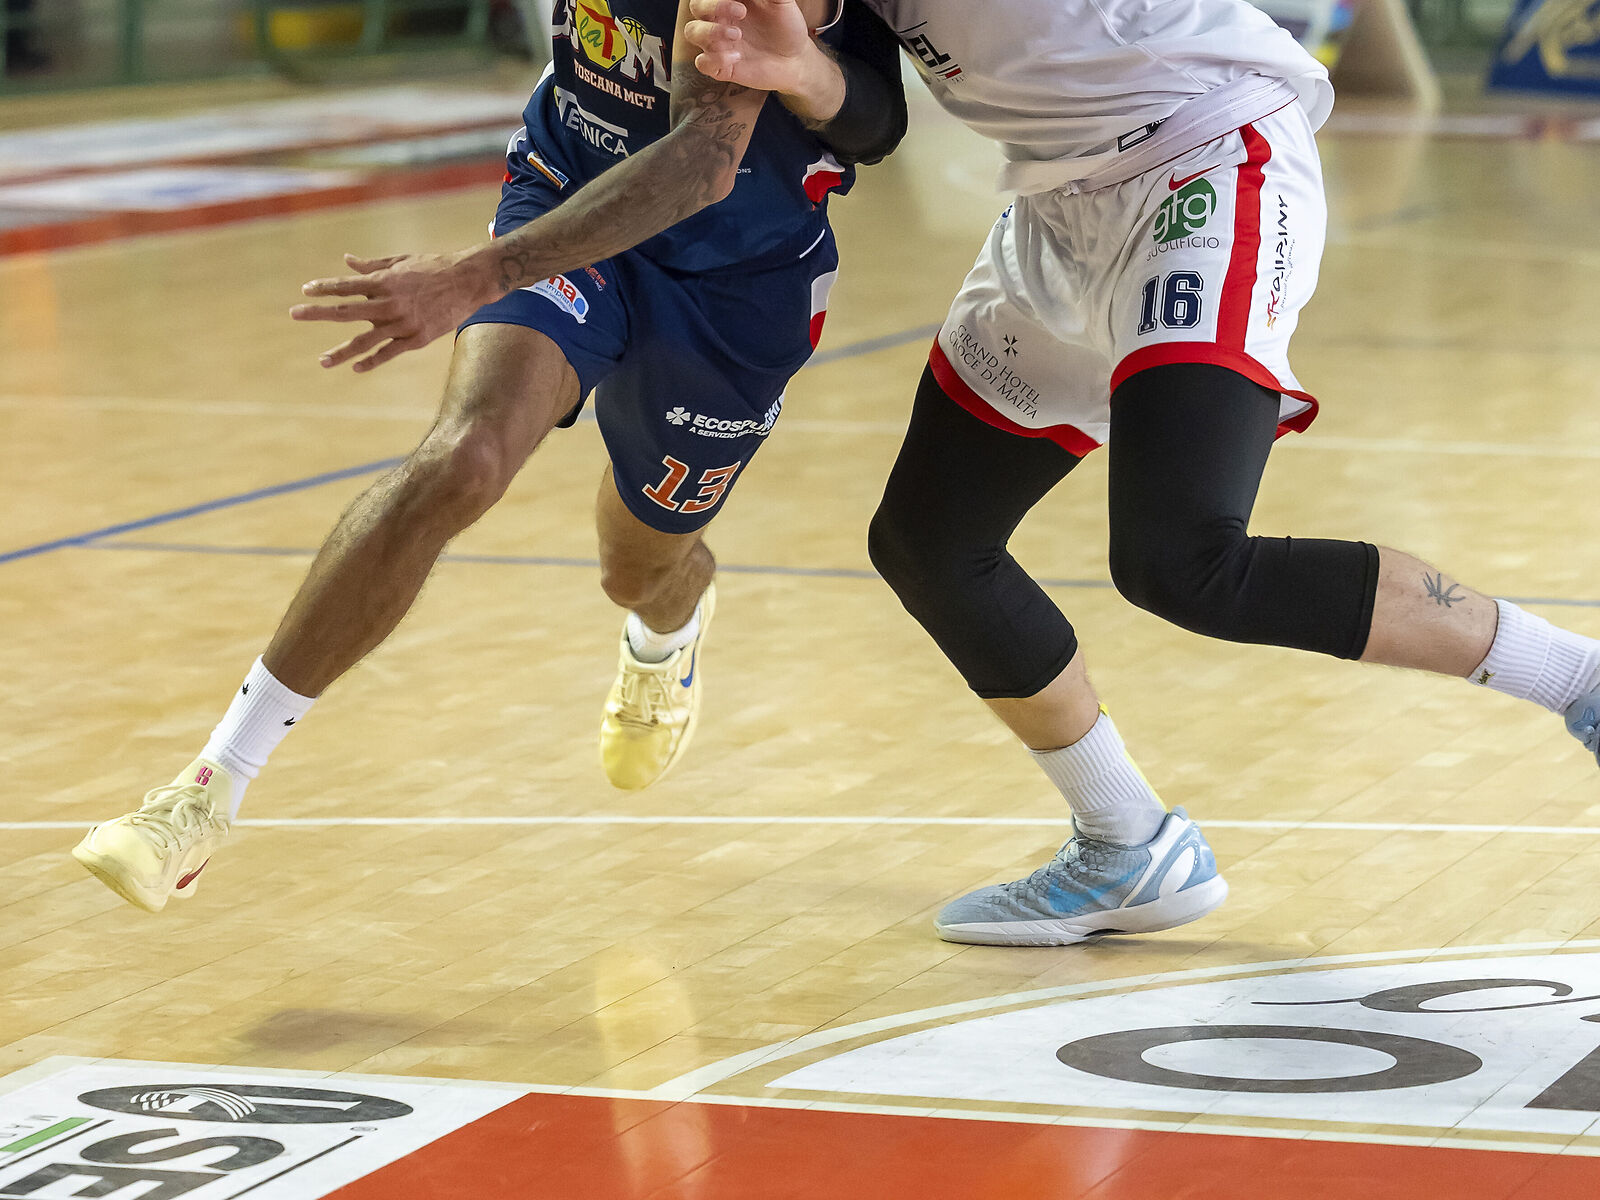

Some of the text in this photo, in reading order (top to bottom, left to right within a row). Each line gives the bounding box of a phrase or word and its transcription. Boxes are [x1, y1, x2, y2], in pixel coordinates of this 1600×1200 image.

[623, 87, 656, 110] MCT
[1138, 270, 1204, 336] 16
[949, 330, 1038, 420] CROCE DI MALTA
[957, 324, 1041, 405] GRAND HOTEL
[697, 429, 737, 439] SERVIZIO
[642, 454, 742, 514] 13
